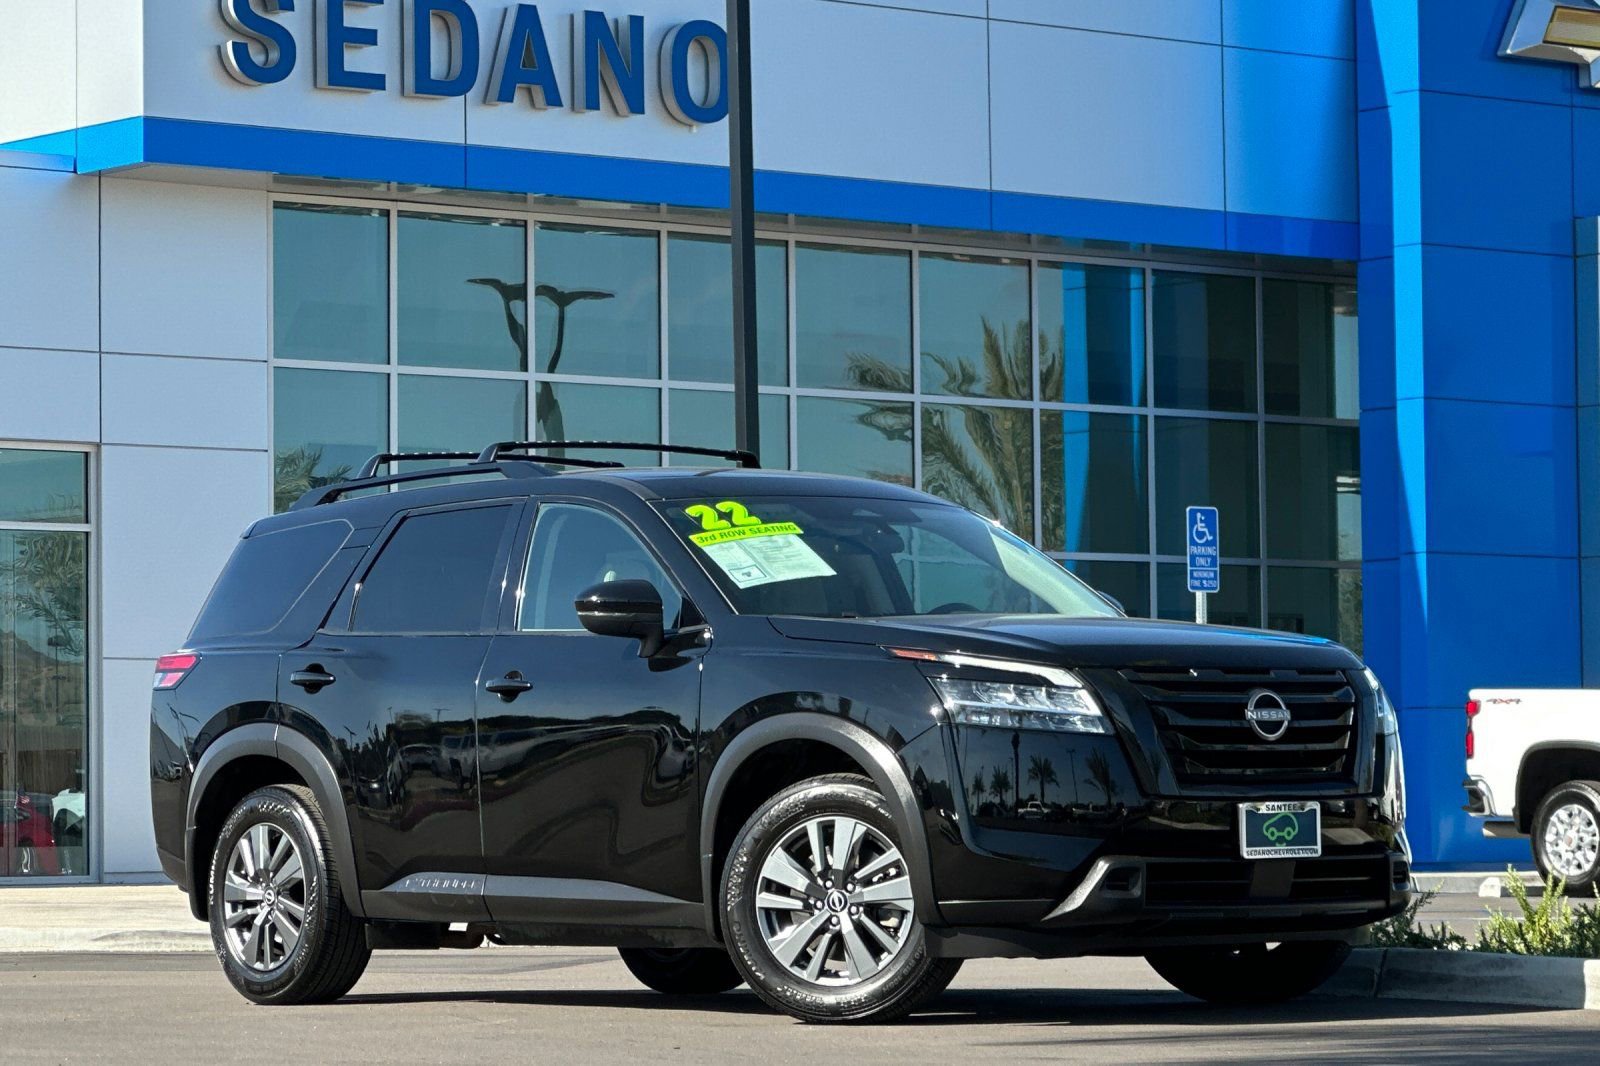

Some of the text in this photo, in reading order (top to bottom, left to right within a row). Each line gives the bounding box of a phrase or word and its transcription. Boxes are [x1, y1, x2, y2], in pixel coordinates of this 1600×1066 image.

[220, 0, 729, 125] SEDANO
[685, 501, 762, 530] 22
[697, 524, 796, 543] 3rd ROW SEATING
[1190, 546, 1217, 556] PARKING
[1195, 557, 1211, 566] ONLY
[1248, 710, 1290, 719] NISSAN
[1265, 803, 1297, 811] SANTEE
